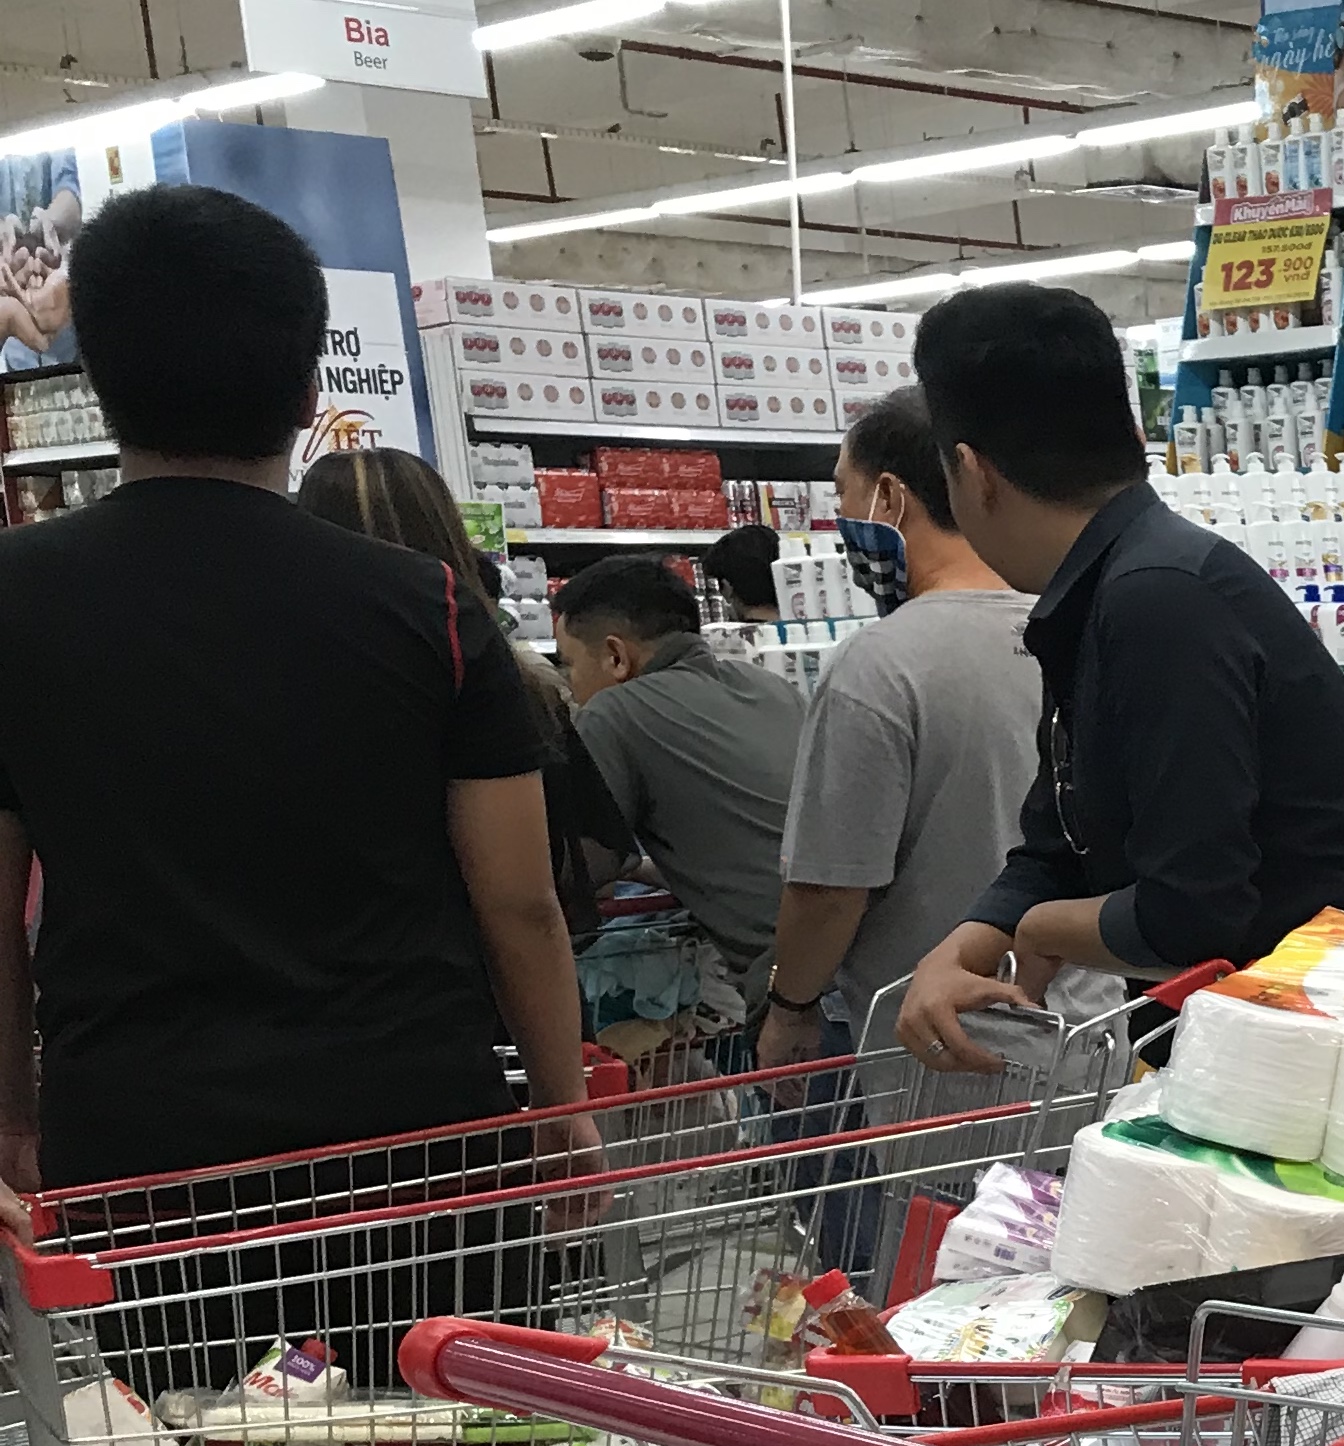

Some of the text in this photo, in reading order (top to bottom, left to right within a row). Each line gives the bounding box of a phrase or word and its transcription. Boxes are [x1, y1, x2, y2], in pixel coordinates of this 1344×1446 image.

[344, 16, 391, 48] Bia
[353, 51, 389, 71] Beer
[1221, 258, 1277, 292] 123
[326, 363, 404, 401] NGHIỆP
